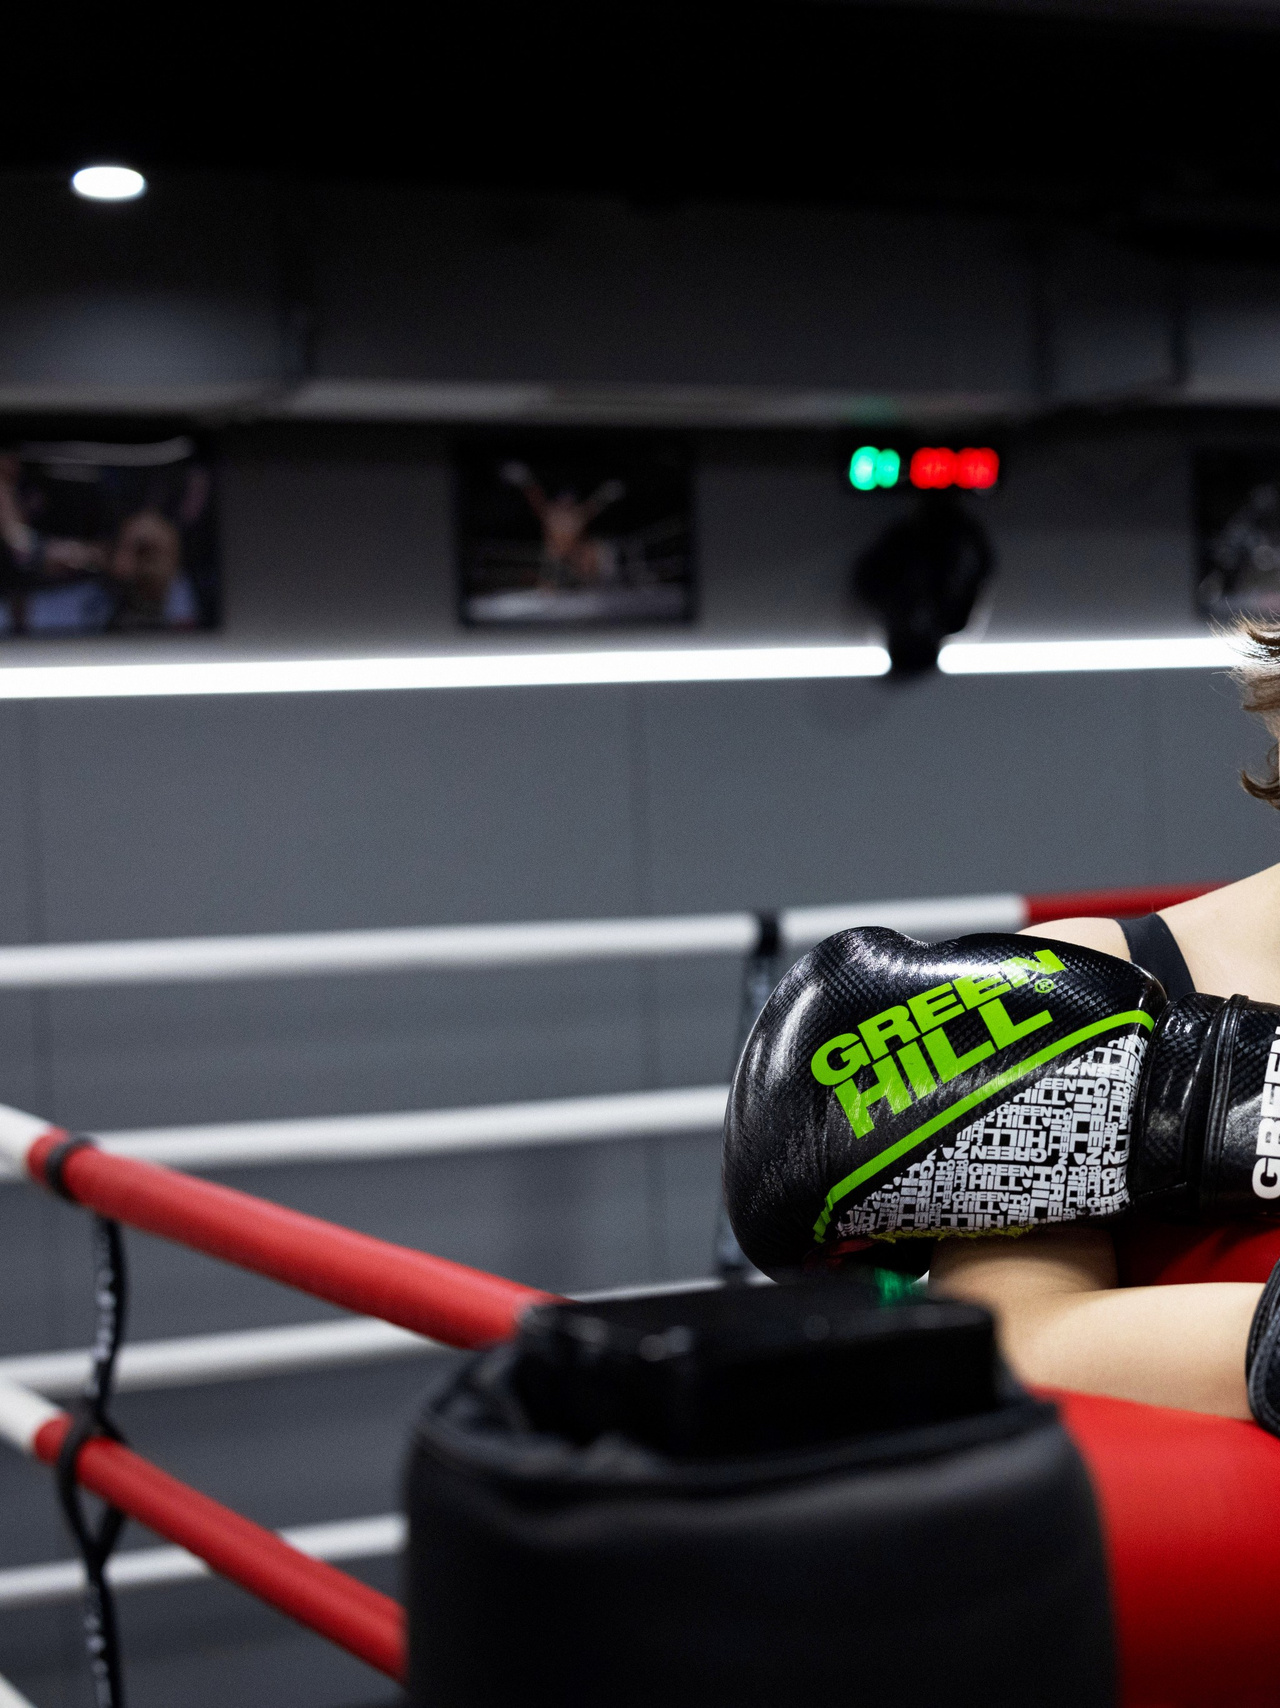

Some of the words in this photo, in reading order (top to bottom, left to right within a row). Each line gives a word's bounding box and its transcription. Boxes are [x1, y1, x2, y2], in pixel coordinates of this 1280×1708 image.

[811, 949, 1067, 1086] GREEN
[834, 998, 1054, 1140] HILL
[996, 1103, 1052, 1118] GREEN
[1069, 1078, 1096, 1153] HILL
[996, 1114, 1044, 1131] HILL
[1086, 1077, 1110, 1165] GREEN
[984, 1127, 1047, 1149] HILL
[1048, 1108, 1064, 1156] HILL
[1058, 1107, 1073, 1165] GREEN
[970, 1145, 1048, 1163] GREEN
[968, 1162, 1035, 1178] GREEN
[968, 1175, 1023, 1192] HILL
[952, 1191, 1010, 1203] GREEN
[952, 1200, 1001, 1214] HILL
